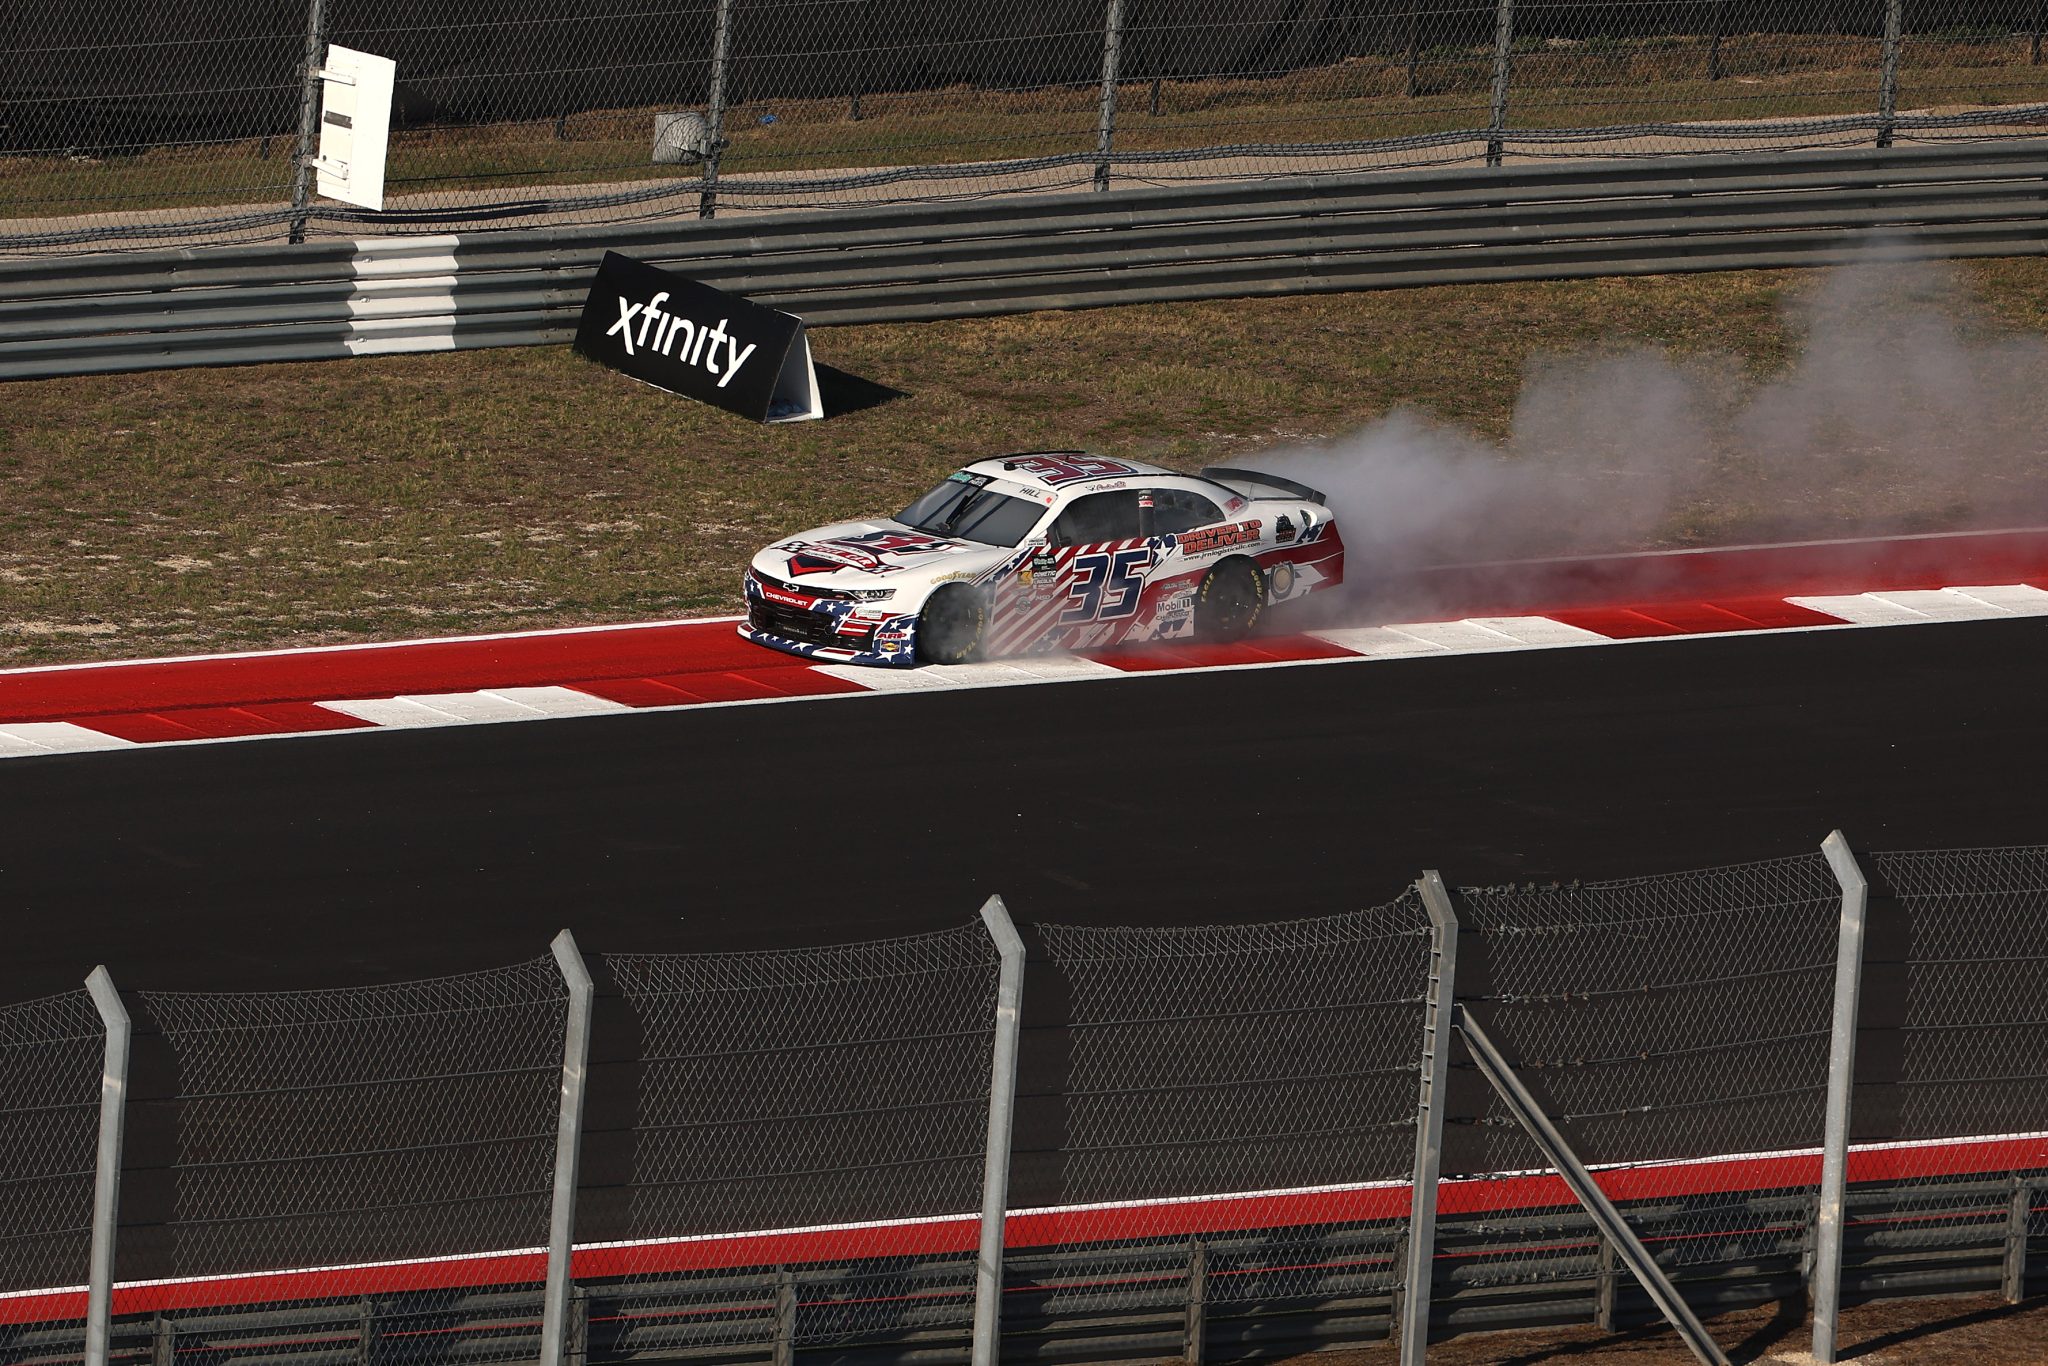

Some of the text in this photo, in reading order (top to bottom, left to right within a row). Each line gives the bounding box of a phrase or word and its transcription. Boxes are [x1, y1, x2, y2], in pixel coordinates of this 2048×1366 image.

[605, 291, 757, 388] xfinity
[1002, 453, 1138, 486] 35
[1019, 487, 1041, 499] HILL
[1177, 519, 1262, 544] DRIVEN TO
[1183, 529, 1261, 556] DELIVER
[765, 591, 809, 607] CHEVROLET
[1058, 547, 1150, 626] 35
[1200, 572, 1214, 603] EAGLE
[1157, 600, 1182, 612] Mobil
[876, 632, 908, 640] ARP
